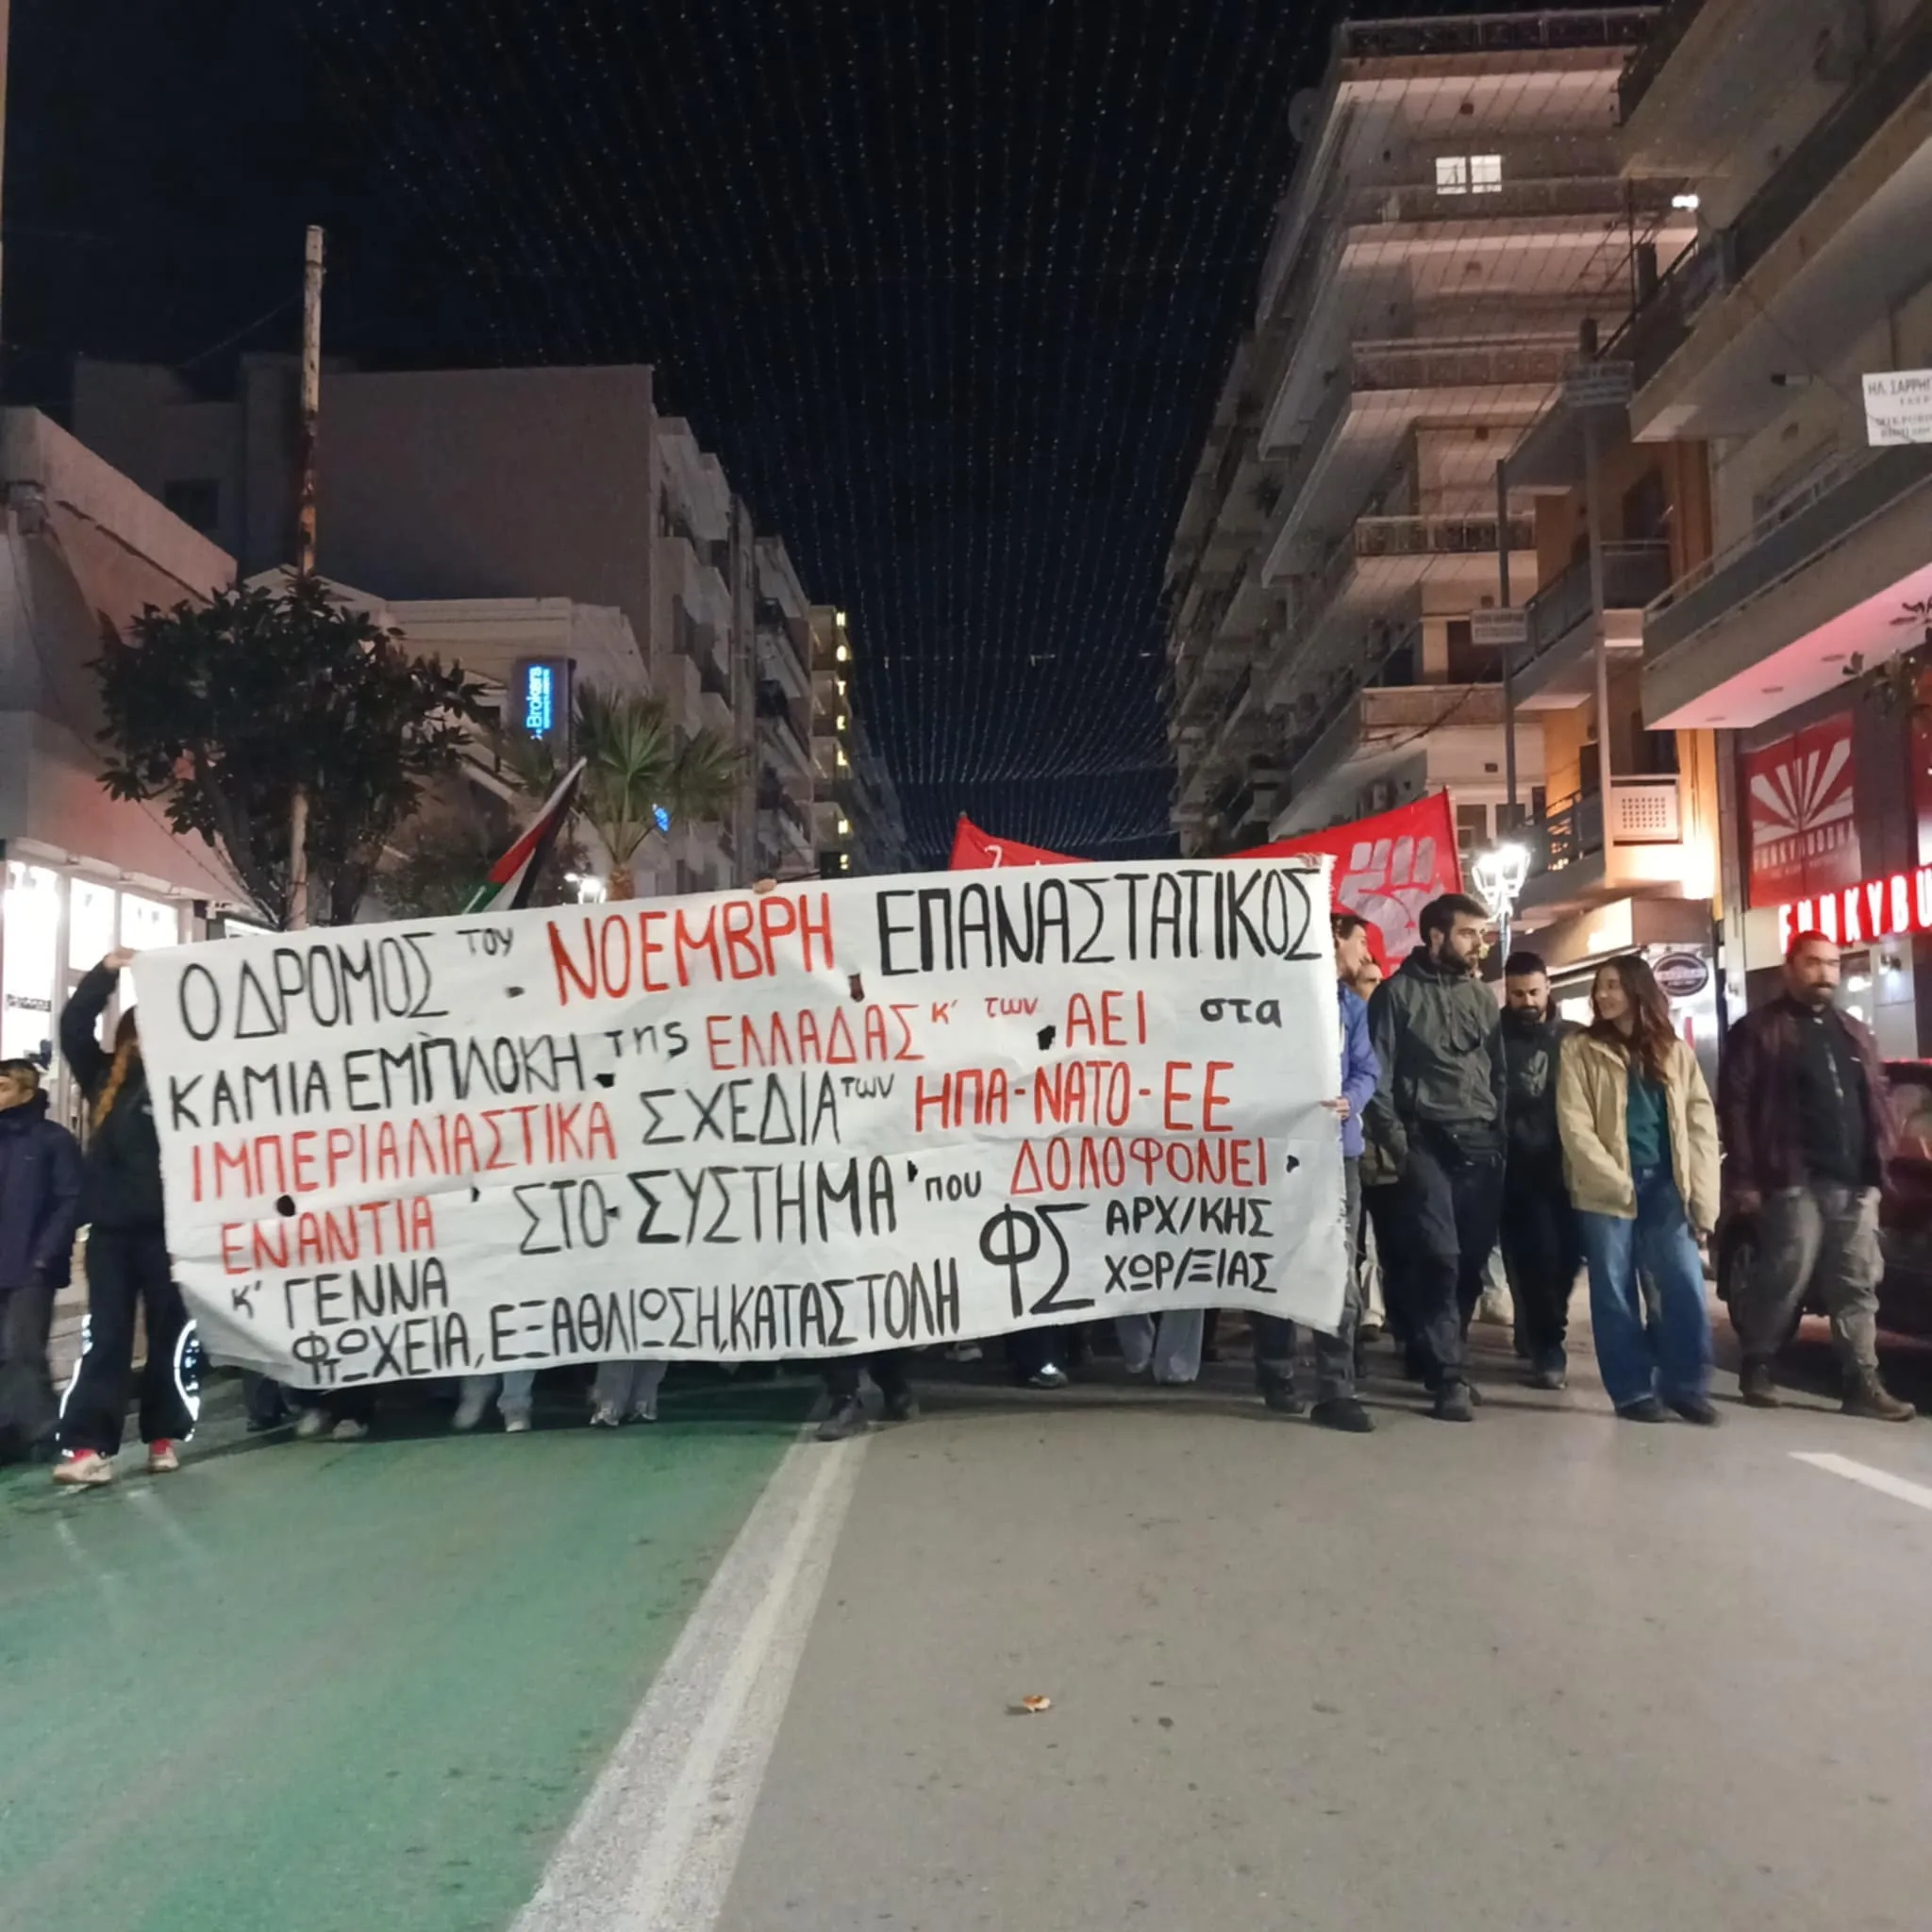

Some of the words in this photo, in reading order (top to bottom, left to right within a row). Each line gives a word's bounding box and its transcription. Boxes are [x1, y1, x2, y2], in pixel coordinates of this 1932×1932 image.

[836, 611, 848, 767] HOTEL
[179, 963, 222, 1041] Ο
[234, 931, 450, 1040] ΔΡΟΜΟΣ
[546, 891, 835, 1007] ΝΟΕΜΒΡΗ
[876, 866, 1323, 977] ΕΠΑΝΑΣΤΑΤΙΚΟΣ
[170, 1059, 331, 1131] ΚΑΜΙΑ
[344, 1034, 585, 1111] ΕΜΠΛΟΚΗ
[706, 1004, 926, 1071] ΕΛΛΑΔΑΣ
[1065, 991, 1148, 1048] ΑΕΙ
[1199, 995, 1282, 1028] στα
[639, 1072, 841, 1146] ΣΧΕΔΙΑ
[220, 1195, 436, 1275] ΕΝΑΝΤΙΑ
[627, 1155, 897, 1247] ΣΥΣΤΗΜΑ
[1009, 1138, 1267, 1196] ΔΟΛΟΦΟΝΕΙ
[1105, 1195, 1274, 1237] ΑΡΧ/ΚΗΣ
[283, 1257, 449, 1329] ΓΕΝΝΑ
